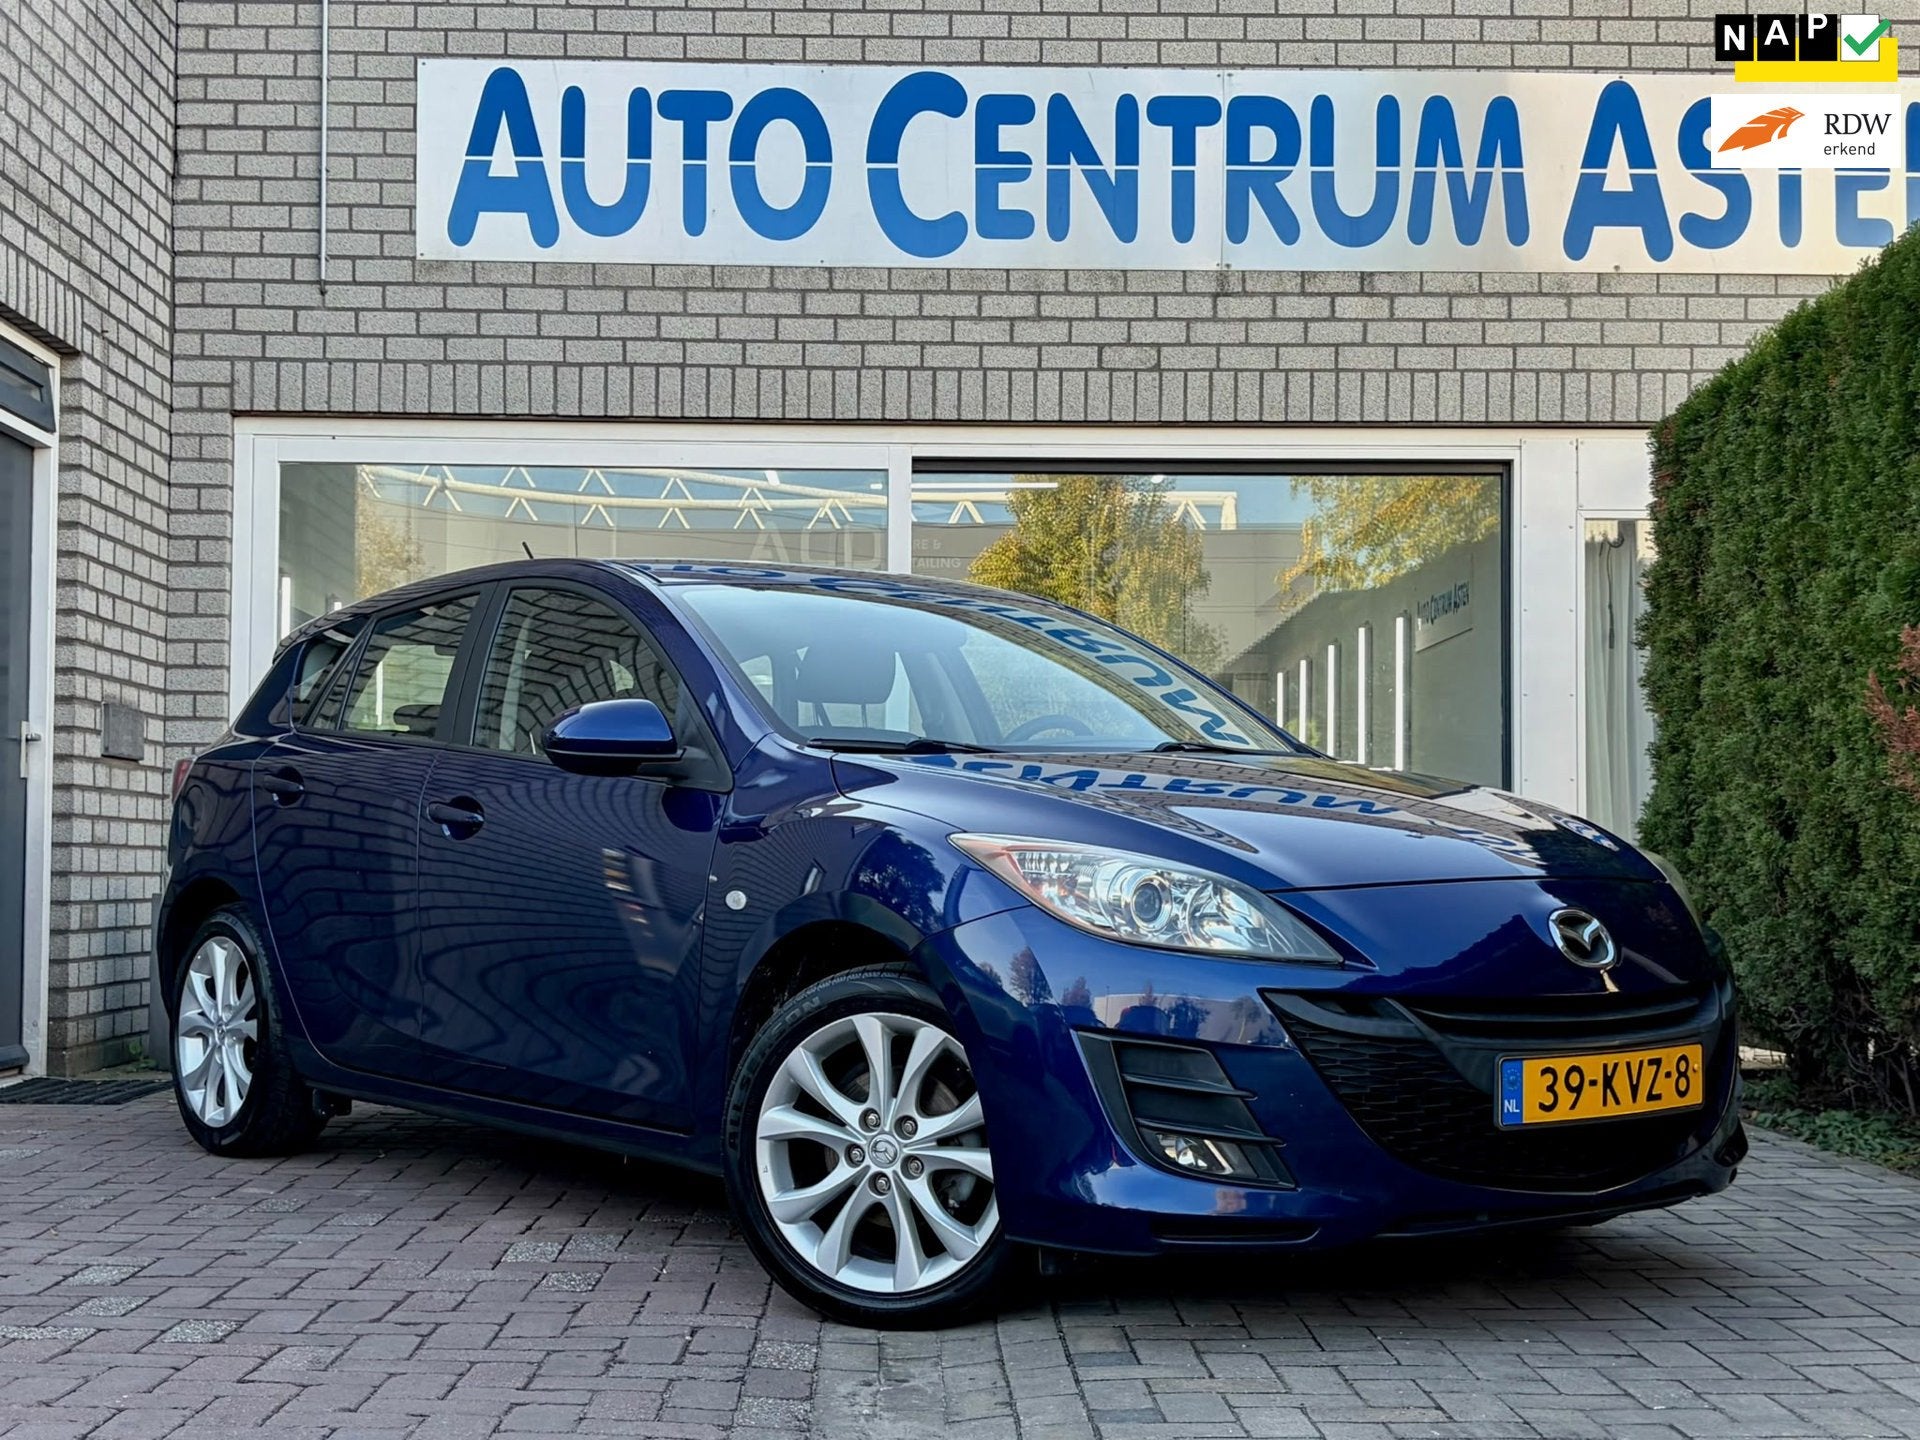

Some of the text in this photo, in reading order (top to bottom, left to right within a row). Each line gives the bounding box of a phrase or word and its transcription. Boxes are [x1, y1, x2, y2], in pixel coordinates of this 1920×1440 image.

[447, 66, 1920, 263] AUTO CENTRUM ASE
[1503, 1099, 1520, 1113] NL
[1538, 1053, 1690, 1113] 39-KVZ-8
